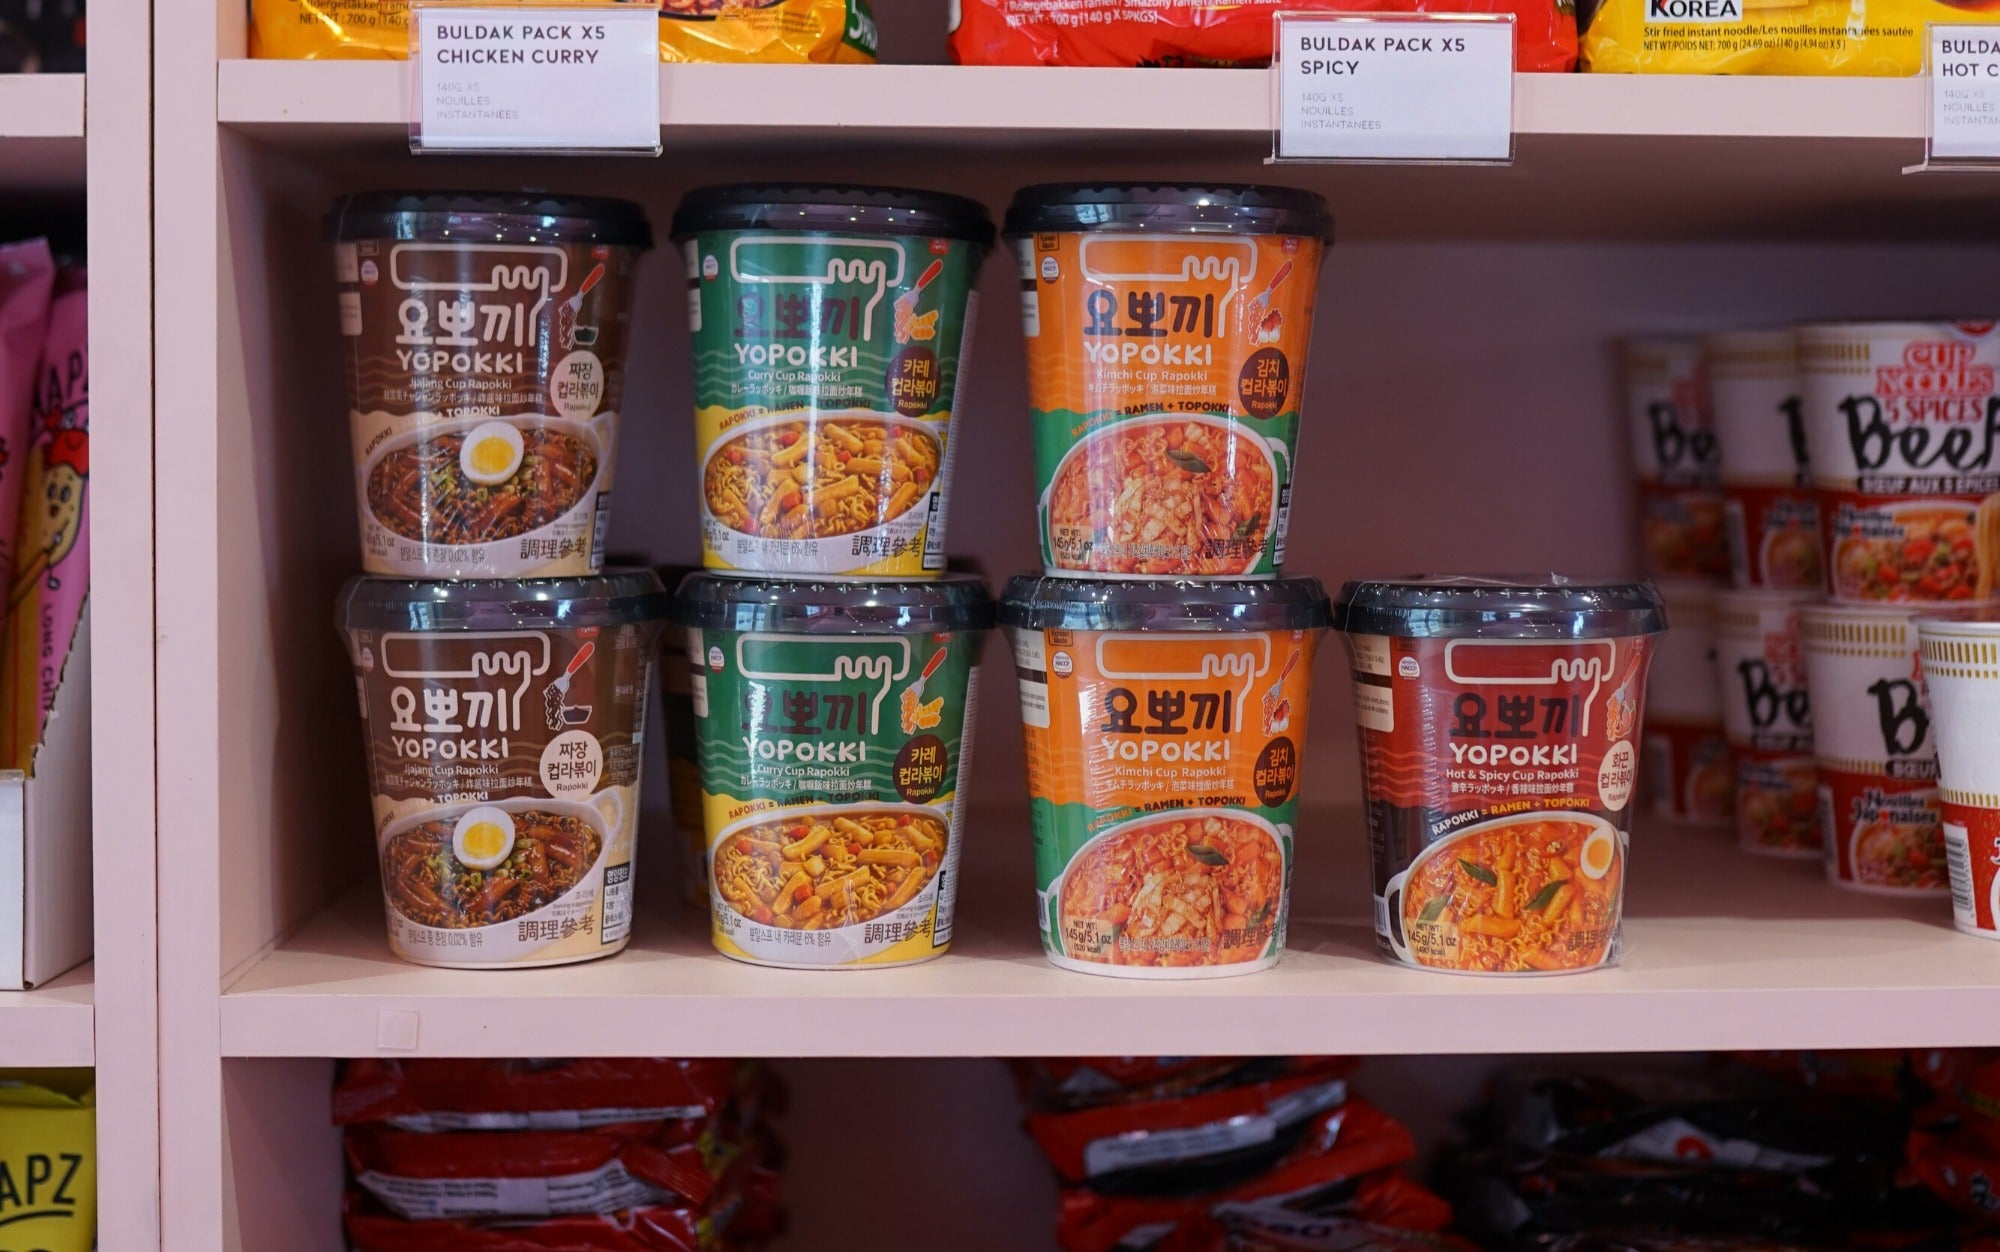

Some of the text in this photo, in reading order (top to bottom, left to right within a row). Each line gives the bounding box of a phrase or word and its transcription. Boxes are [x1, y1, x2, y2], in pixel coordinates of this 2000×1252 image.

[1650, 0, 1738, 18] KOREA
[347, 14, 367, 24] 700
[437, 26, 605, 40] BULDAK PACK X5
[1644, 26, 1660, 37] Stir
[1663, 26, 1685, 37] fried
[1688, 26, 1721, 37] instant
[1781, 25, 1817, 36] nouilles
[1301, 37, 1465, 52] BULDAK PACK X5
[1643, 41, 1658, 51] NET
[1718, 40, 1731, 50] 700
[1732, 43, 1738, 52] g
[437, 49, 598, 64] CHICKEN CURRY
[1301, 61, 1359, 75] SPICY
[1942, 63, 1980, 77] HOT
[437, 83, 480, 93] 140G X5
[1944, 89, 1985, 99] 140G X5
[436, 96, 490, 107] NOUILLES
[1301, 92, 1344, 103] 140G X5
[1301, 106, 1354, 116] NOUILLES
[1943, 103, 1995, 112] NOUILLES
[734, 293, 860, 340] 요뽀끼
[1083, 289, 1214, 338] 요뽀끼
[396, 298, 525, 347] 요뽀끼
[396, 349, 523, 374] YOPOKKI
[734, 343, 858, 368] YOPOKKI
[1084, 341, 1212, 366] YOPOKKI
[569, 362, 593, 381] 짜장
[748, 370, 841, 383] Curry Cup Rapokki
[903, 358, 930, 378] 카레
[1097, 369, 1207, 382] Kimchi Cup Rapokki
[1256, 358, 1280, 378] 김치
[445, 379, 512, 391] Cup Rapokki
[891, 379, 936, 398] 컵라볶이
[1241, 378, 1287, 398] 컵라볶이
[446, 405, 500, 417] TOPOKKI
[898, 400, 928, 410] Rapokki
[1904, 396, 1982, 423] SPICES
[719, 398, 872, 431] RAPOKKI RAMEN TOPOKKI
[1072, 401, 1230, 438] RAPOKKI RAMEN TOPOKKI
[390, 686, 507, 733] 요뽀끼
[742, 690, 867, 735] 요뽀끼
[1101, 687, 1232, 735] 요뽀끼
[1449, 693, 1579, 738] 요뽀끼
[391, 736, 509, 759] YOPOKKI
[559, 741, 588, 760] 짜장
[742, 736, 866, 762] YOPOKKI
[911, 746, 936, 764] 카레
[1101, 738, 1230, 762] YOPOKKI
[1449, 743, 1577, 766] YOPOKKI
[1269, 747, 1289, 767] 김치
[435, 765, 454, 776] Cup
[455, 764, 499, 776] Rapokki
[547, 759, 597, 781] 컵라볶이
[757, 765, 850, 778] Curry Cup Rapokki
[899, 764, 942, 786] 컵라볶이
[1115, 766, 1226, 778] Kimchi Cup Rapokki
[1446, 769, 1579, 782] Hot & Spicy Cup Rapokki
[556, 782, 589, 793] Rapokki
[907, 788, 935, 797] Rapokki
[438, 791, 489, 804] TOPOKKI
[729, 803, 766, 820] RAPOKKI
[828, 792, 880, 803] TOPOKKI
[1144, 798, 1184, 813] RAMEN
[1198, 796, 1246, 807] TOPOKKI
[1432, 798, 1590, 836] RAPOKKI RAMEN TOPOKKI
[1073, 920, 1084, 929] NET
[1416, 923, 1427, 931] NET
[469, 932, 483, 948] 함유
[749, 928, 832, 947] 분말스프 내 카레분 6% 함유
[1101, 935, 1112, 945] oz
[1446, 937, 1457, 947] oz
